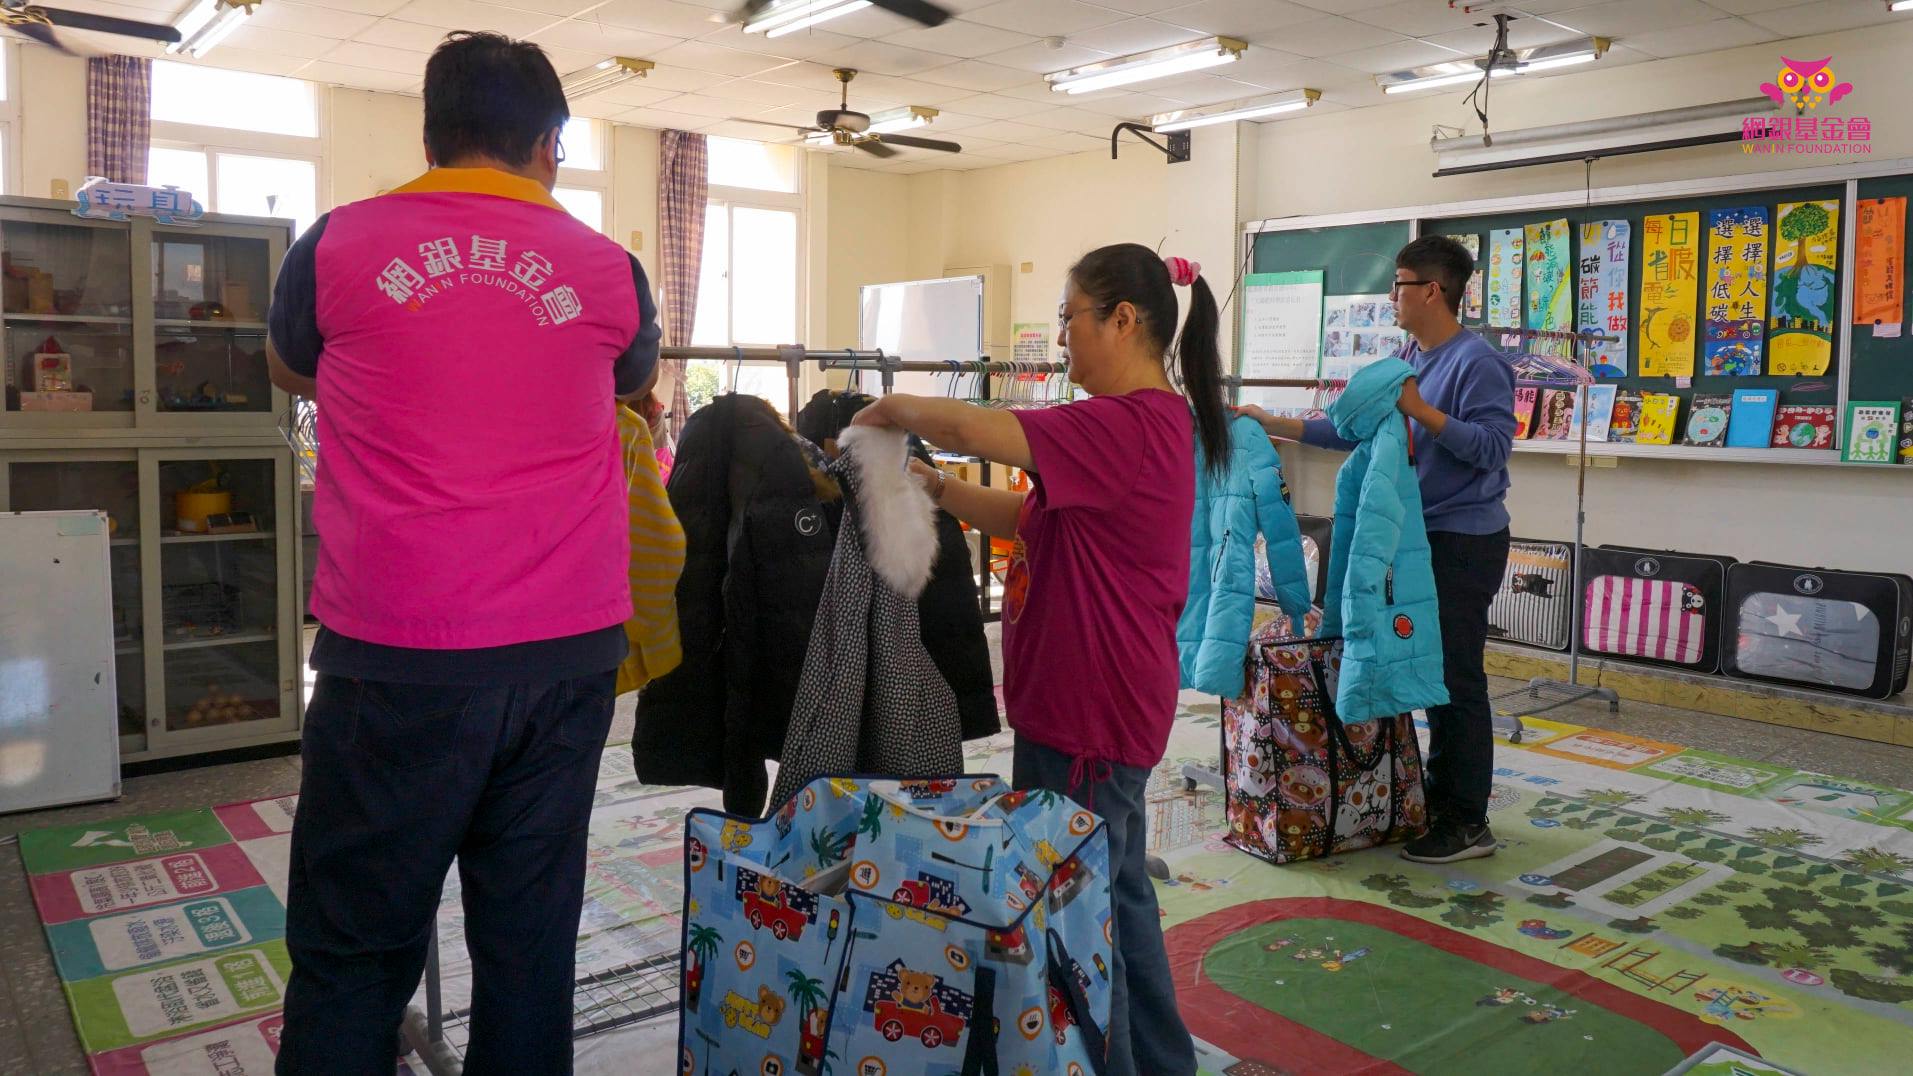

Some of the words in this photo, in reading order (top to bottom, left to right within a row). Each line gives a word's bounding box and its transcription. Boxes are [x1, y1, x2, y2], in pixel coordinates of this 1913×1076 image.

[376, 235, 583, 325] 網銀基金會
[408, 277, 454, 312] WANIN
[459, 273, 550, 327] FOUNDATION
[1711, 217, 1735, 323] 選擇低碳
[1739, 217, 1763, 321] 選擇人生
